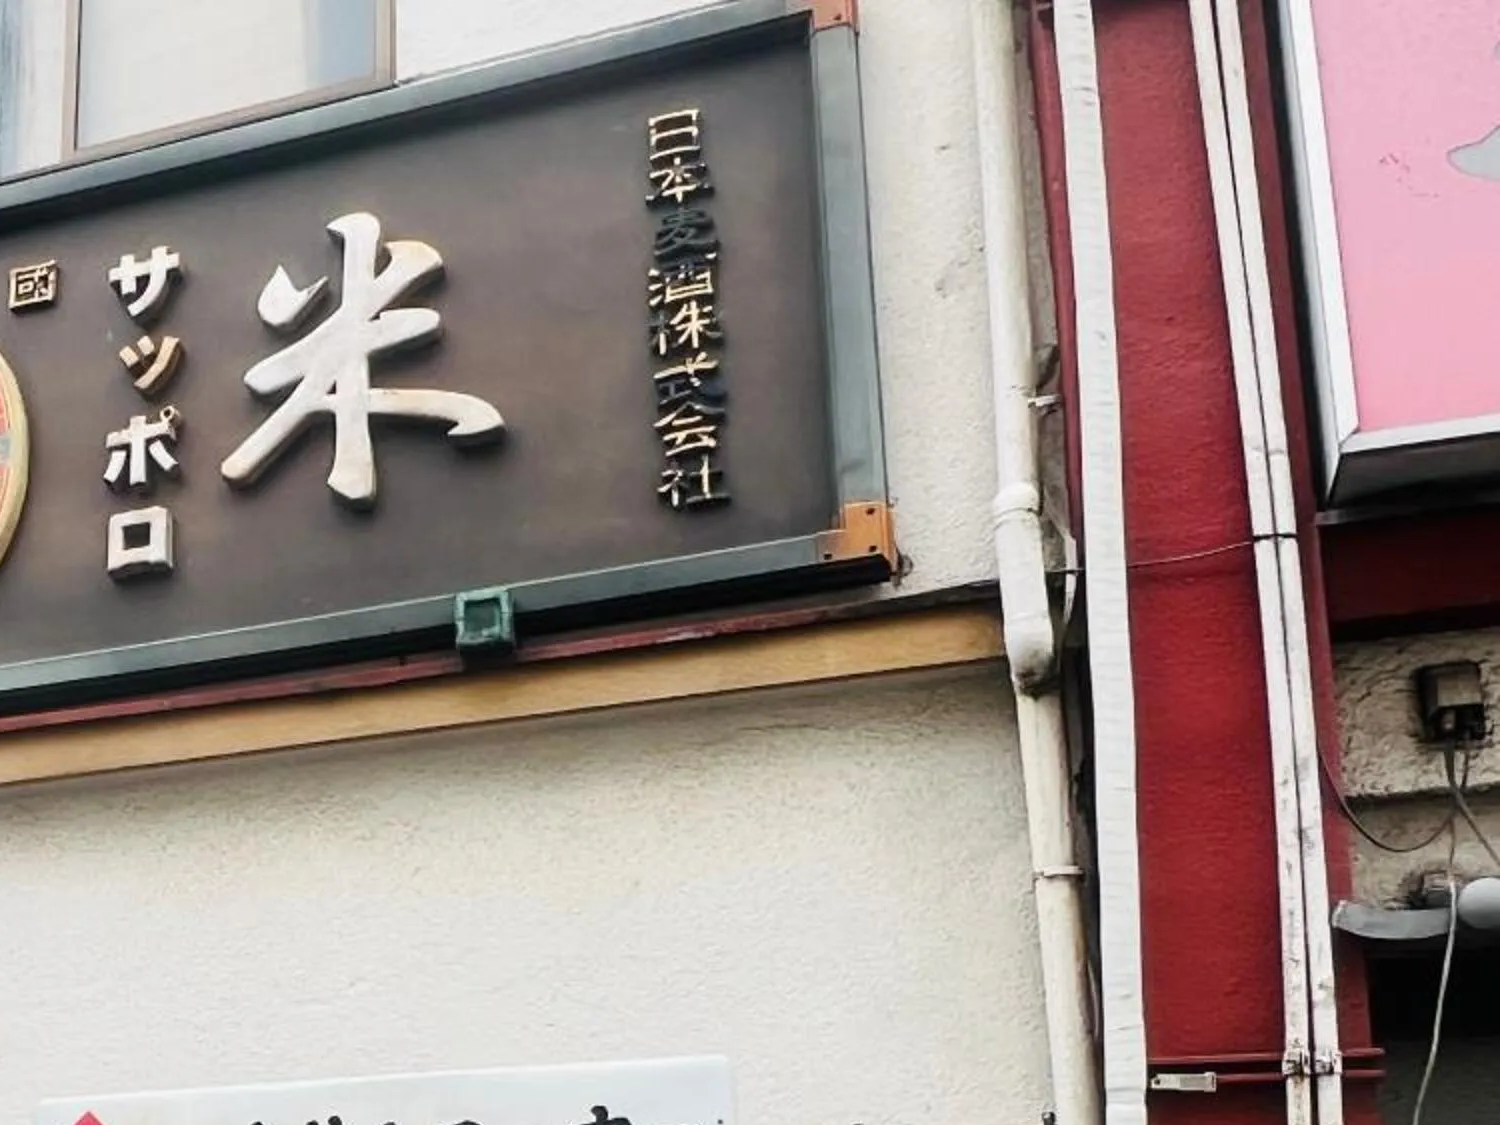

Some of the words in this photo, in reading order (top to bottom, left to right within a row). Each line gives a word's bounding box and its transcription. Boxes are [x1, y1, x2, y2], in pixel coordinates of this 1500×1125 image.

[103, 245, 183, 581] サッポロ
[221, 212, 507, 507] 米
